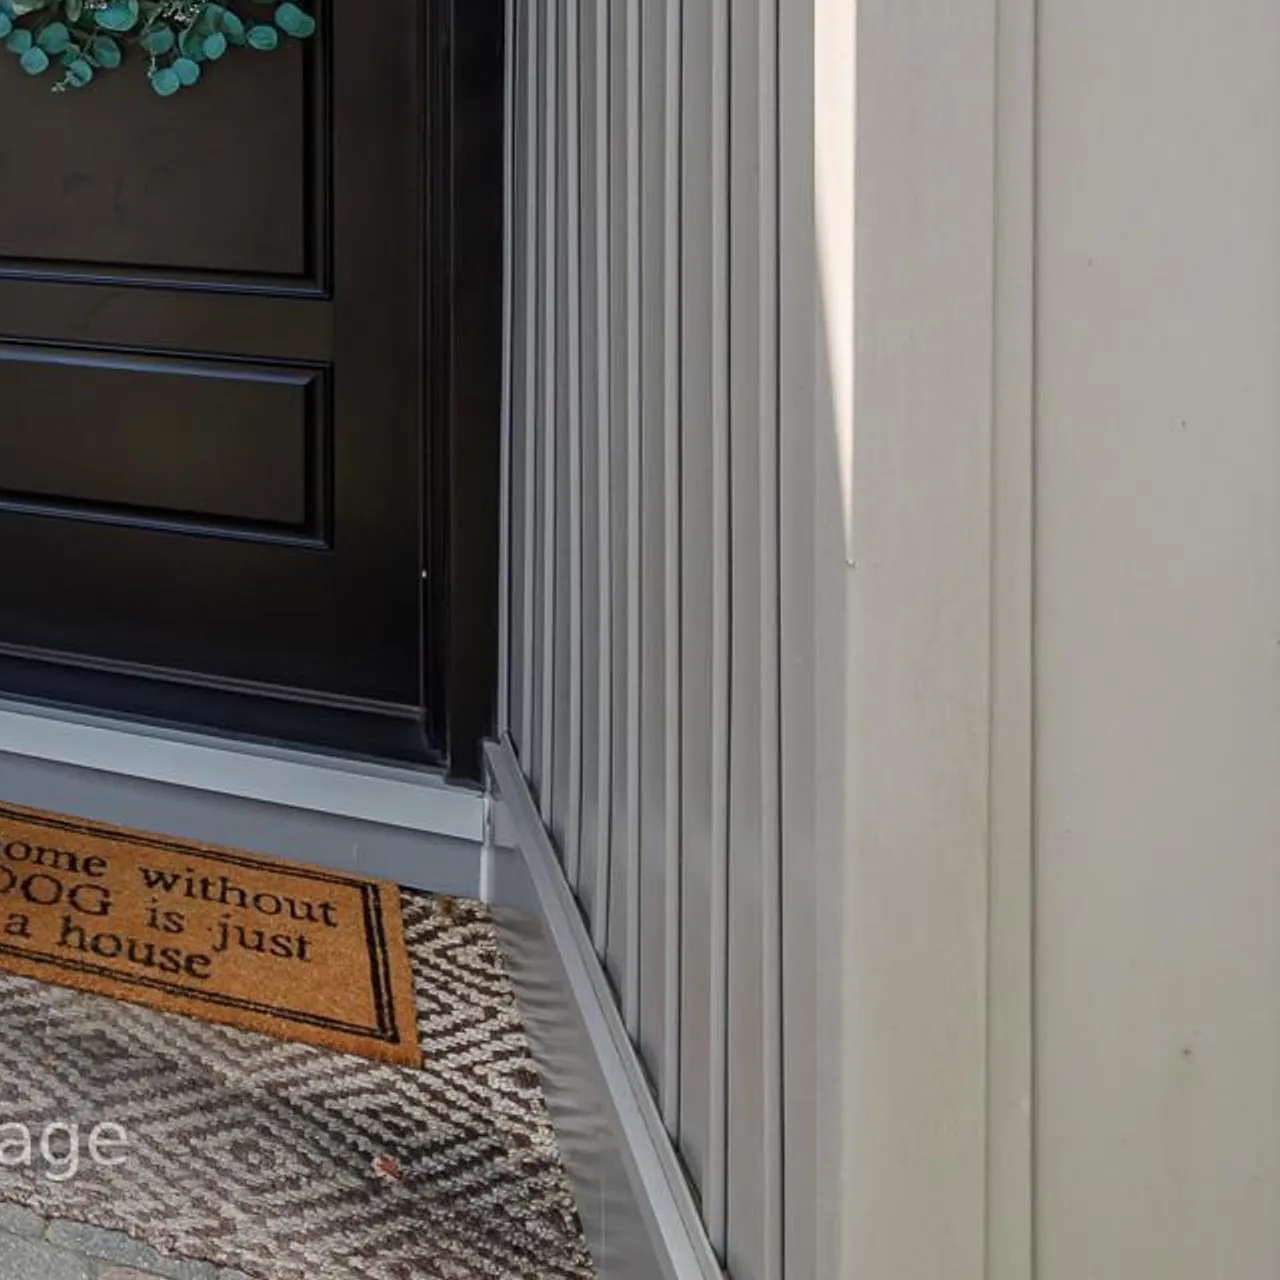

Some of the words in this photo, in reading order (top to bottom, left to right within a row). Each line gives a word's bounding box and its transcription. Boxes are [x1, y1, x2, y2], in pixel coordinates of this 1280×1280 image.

[140, 866, 338, 927] without
[145, 896, 186, 935] is
[211, 912, 313, 963] just
[3, 910, 31, 937] a
[56, 915, 212, 980] house
